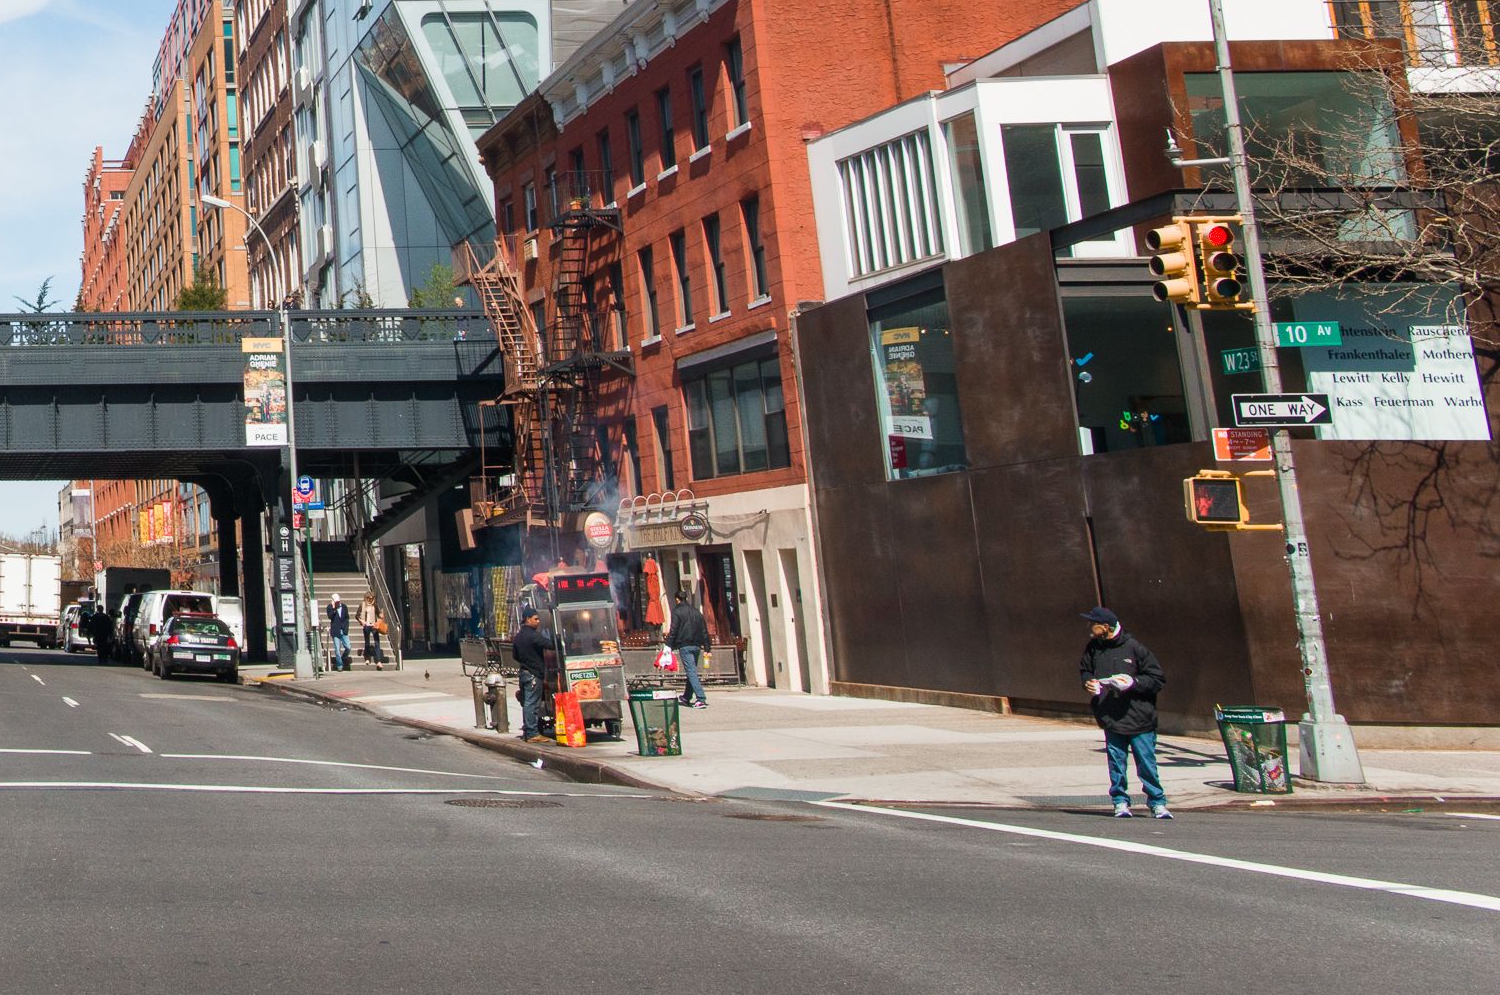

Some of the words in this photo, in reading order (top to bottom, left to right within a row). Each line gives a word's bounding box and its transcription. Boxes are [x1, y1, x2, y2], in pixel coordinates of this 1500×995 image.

[1285, 325, 1308, 343] 10
[1317, 324, 1332, 336] Av
[1341, 326, 1396, 336] htenstein
[1328, 349, 1410, 360] Frankenthaler
[1224, 354, 1236, 371] W
[1238, 352, 1250, 370] 23
[1332, 373, 1370, 383] Lewitt
[1382, 373, 1410, 384] Kelly
[1422, 372, 1464, 383] Hewitt
[1336, 397, 1363, 407] Kass
[1374, 396, 1434, 407] Feuerman
[1248, 404, 1276, 416] ONE
[1288, 404, 1316, 416] WAY
[255, 433, 278, 441] PACE
